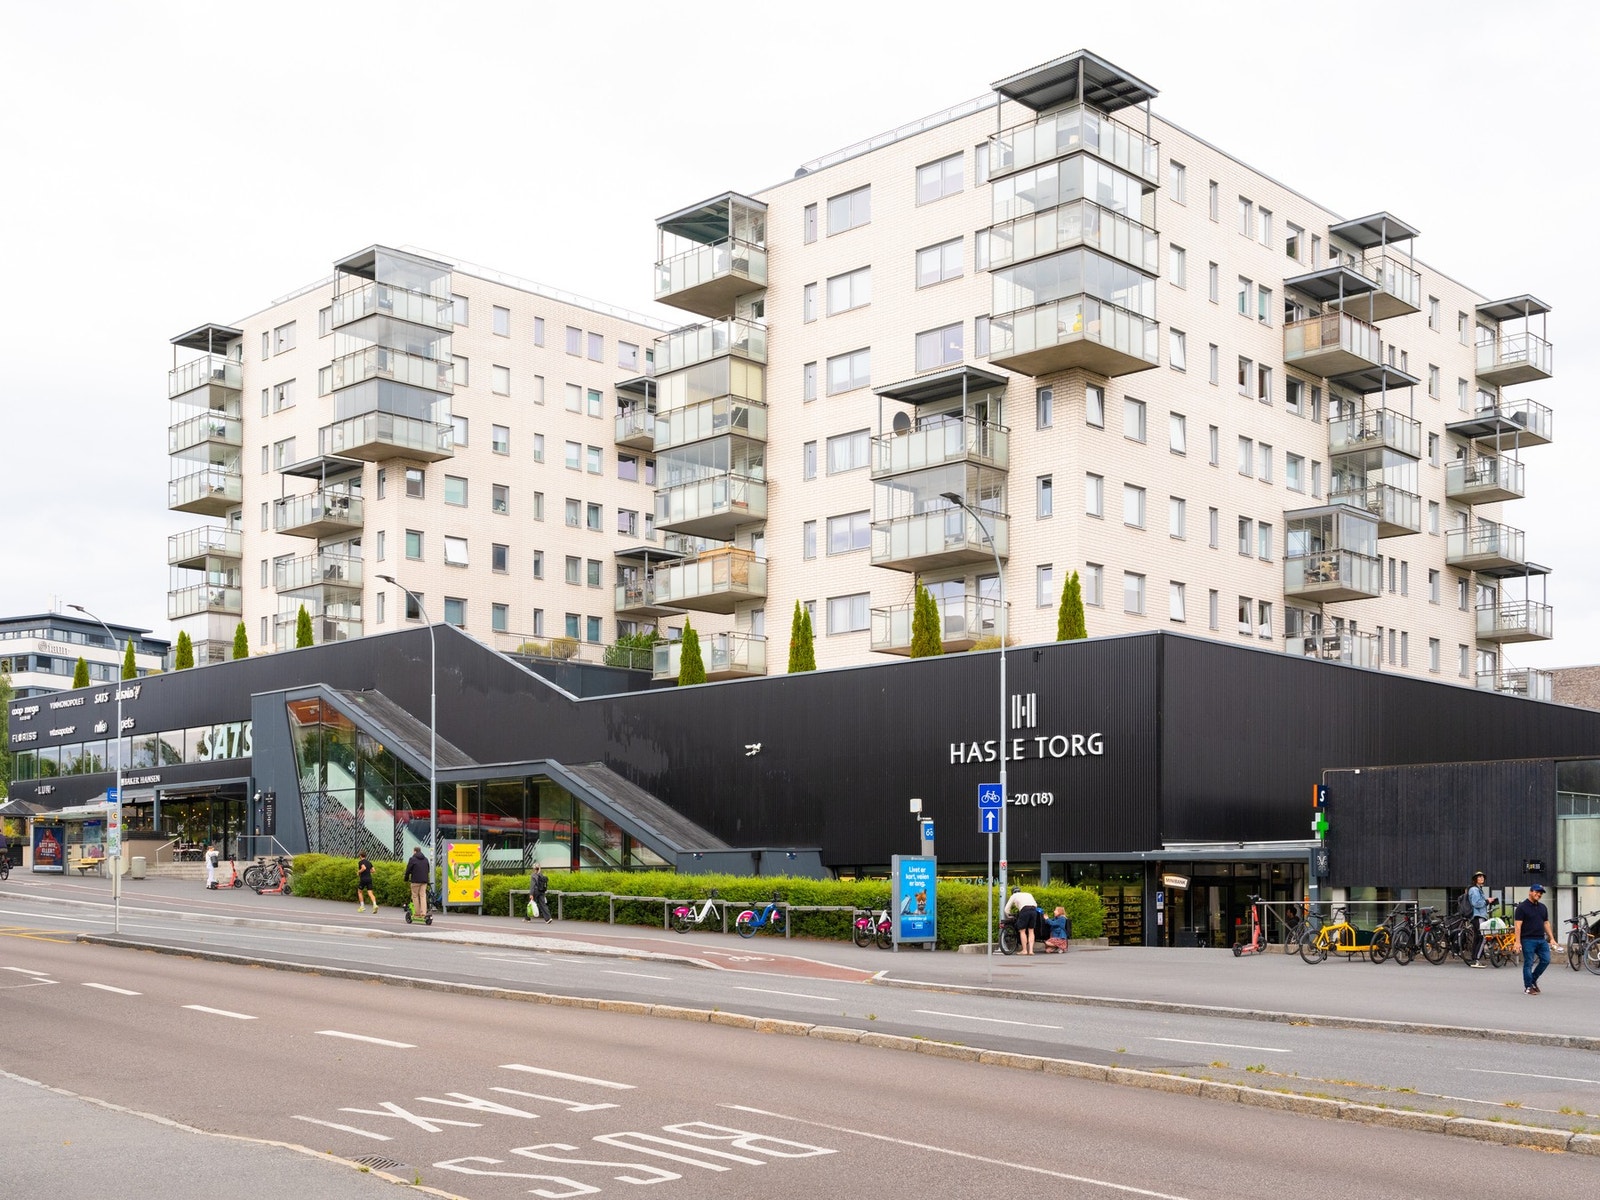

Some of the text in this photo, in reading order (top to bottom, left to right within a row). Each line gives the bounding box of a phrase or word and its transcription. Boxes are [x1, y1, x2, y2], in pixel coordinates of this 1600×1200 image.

[50, 697, 84, 709] VINMONOPOLET
[94, 692, 109, 704] SATS
[200, 721, 252, 761] SATS
[1034, 733, 1104, 759] TORG
[140, 775, 160, 783] HANSEN
[1006, 792, 1054, 807] -20 (18)
[1166, 877, 1186, 885] MINIBANK
[291, 1087, 620, 1140] TAXI
[432, 1121, 839, 1199] BUSS
